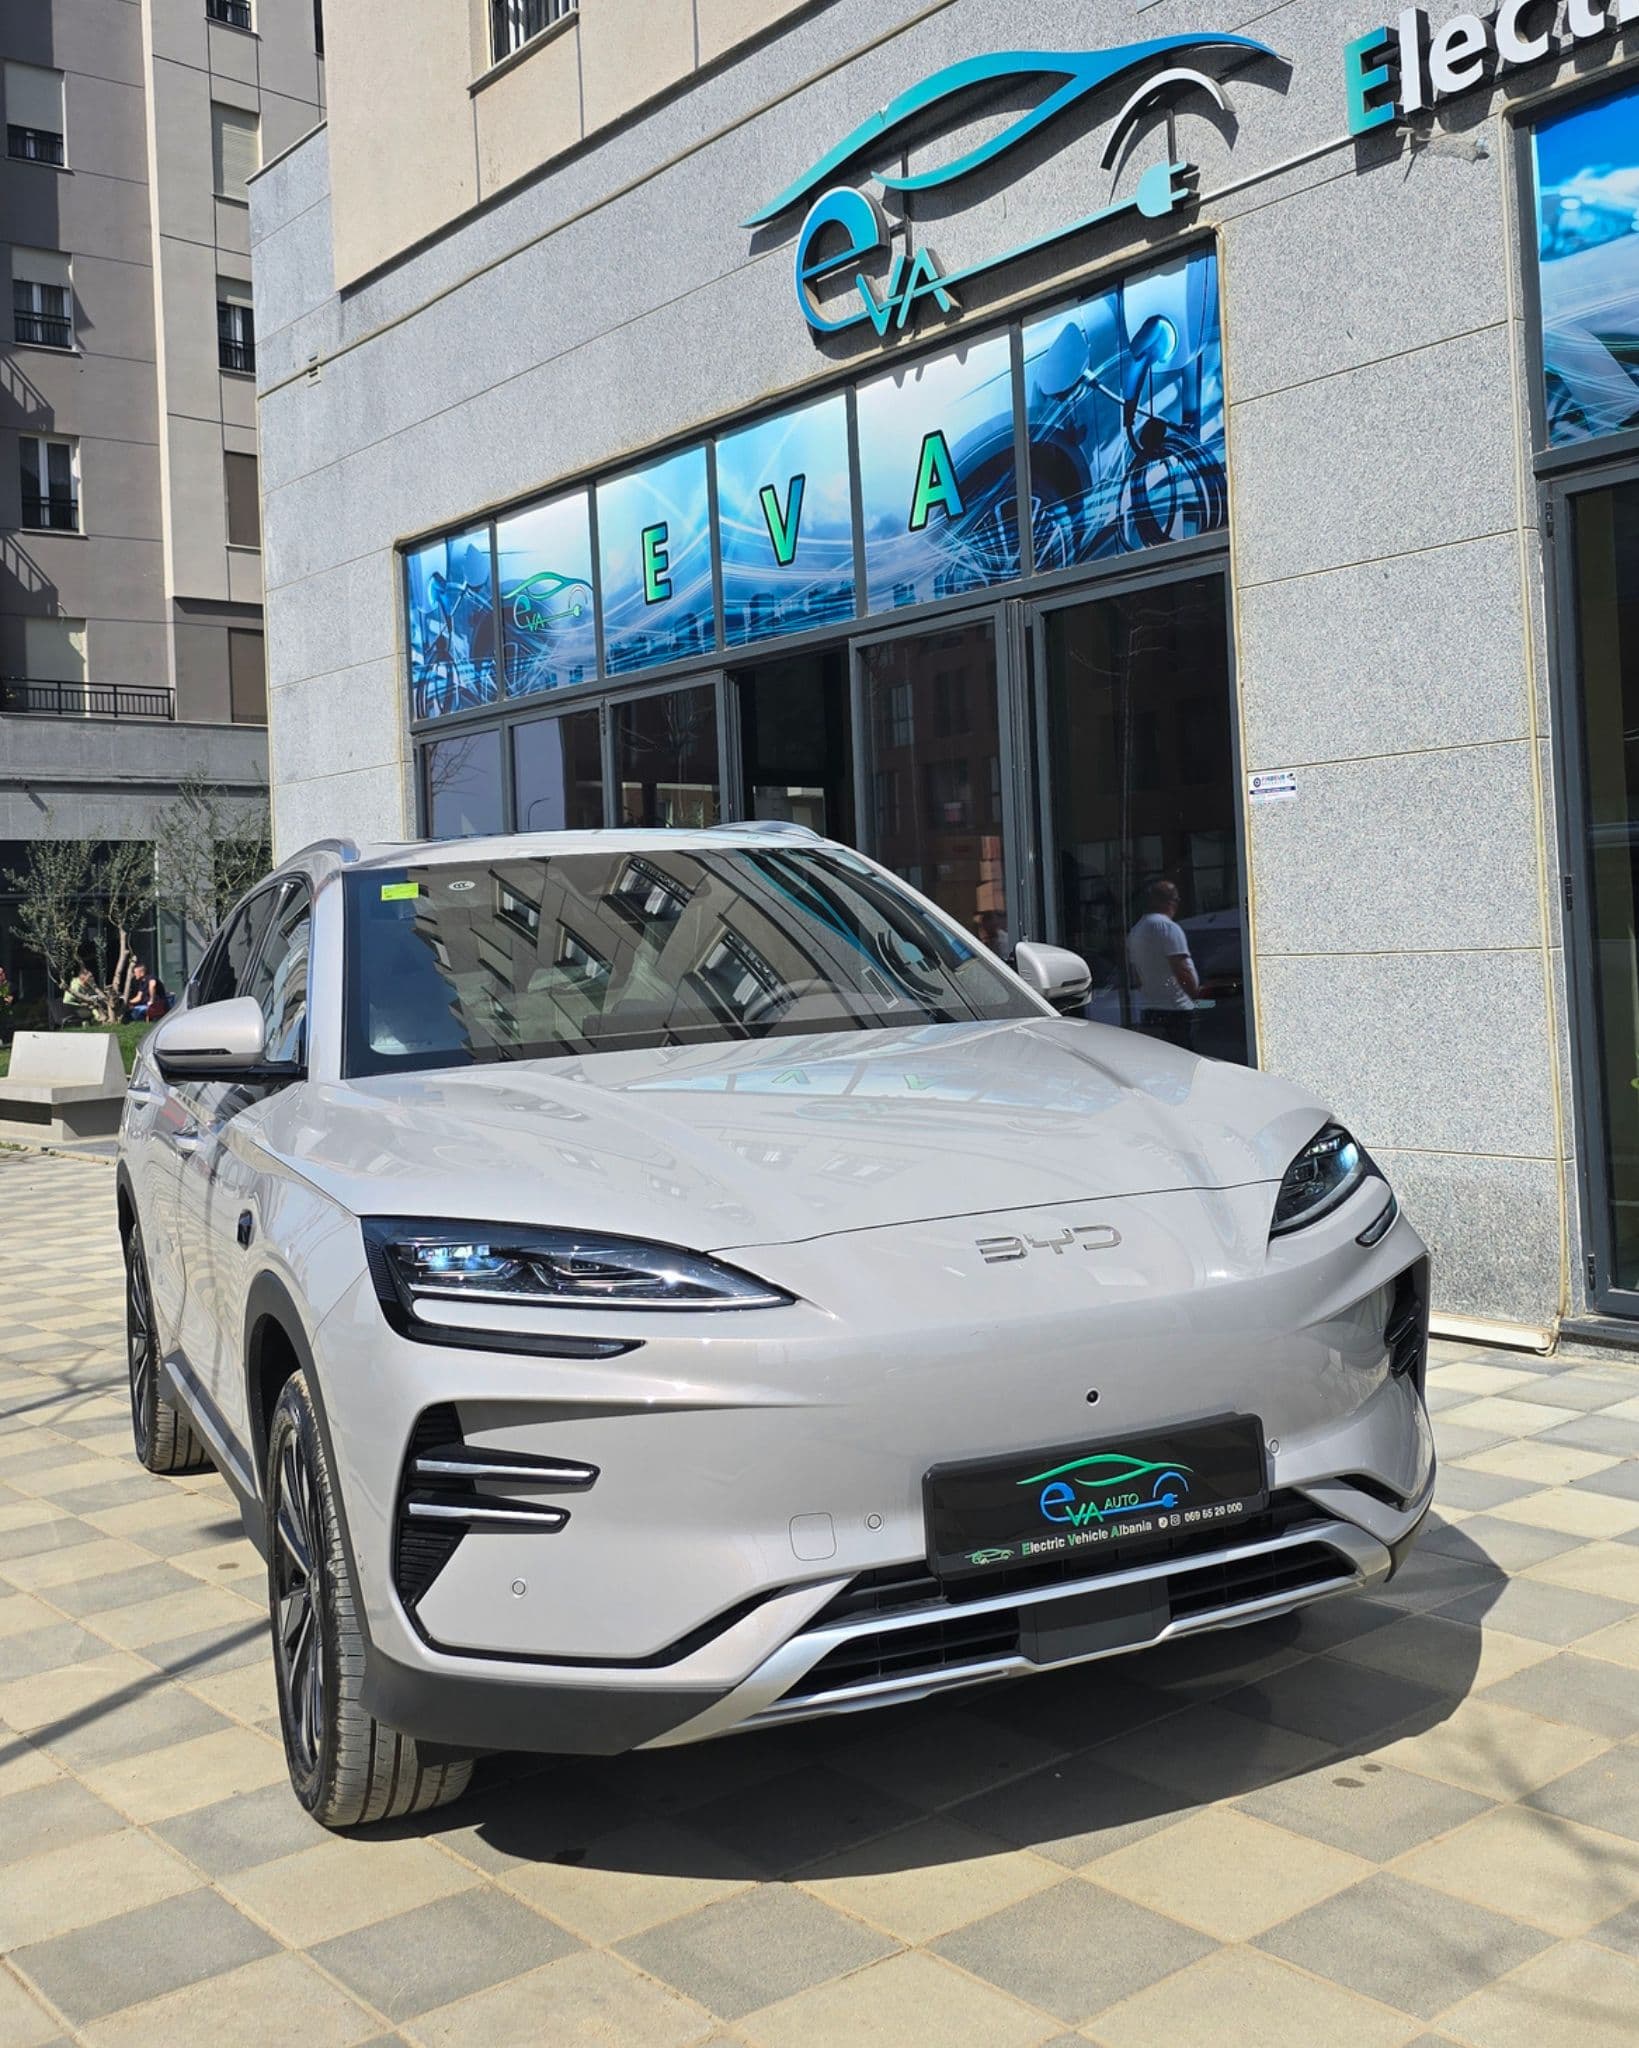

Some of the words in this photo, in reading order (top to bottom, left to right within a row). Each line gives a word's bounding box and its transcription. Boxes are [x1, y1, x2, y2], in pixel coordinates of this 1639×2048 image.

[1344, 0, 1639, 136] Elec
[975, 1224, 1122, 1264] BYD
[1104, 1493, 1140, 1510] AUTO
[1021, 1537, 1065, 1556] Electric
[1067, 1529, 1109, 1546] Vehicle
[1110, 1520, 1152, 1538] Albania
